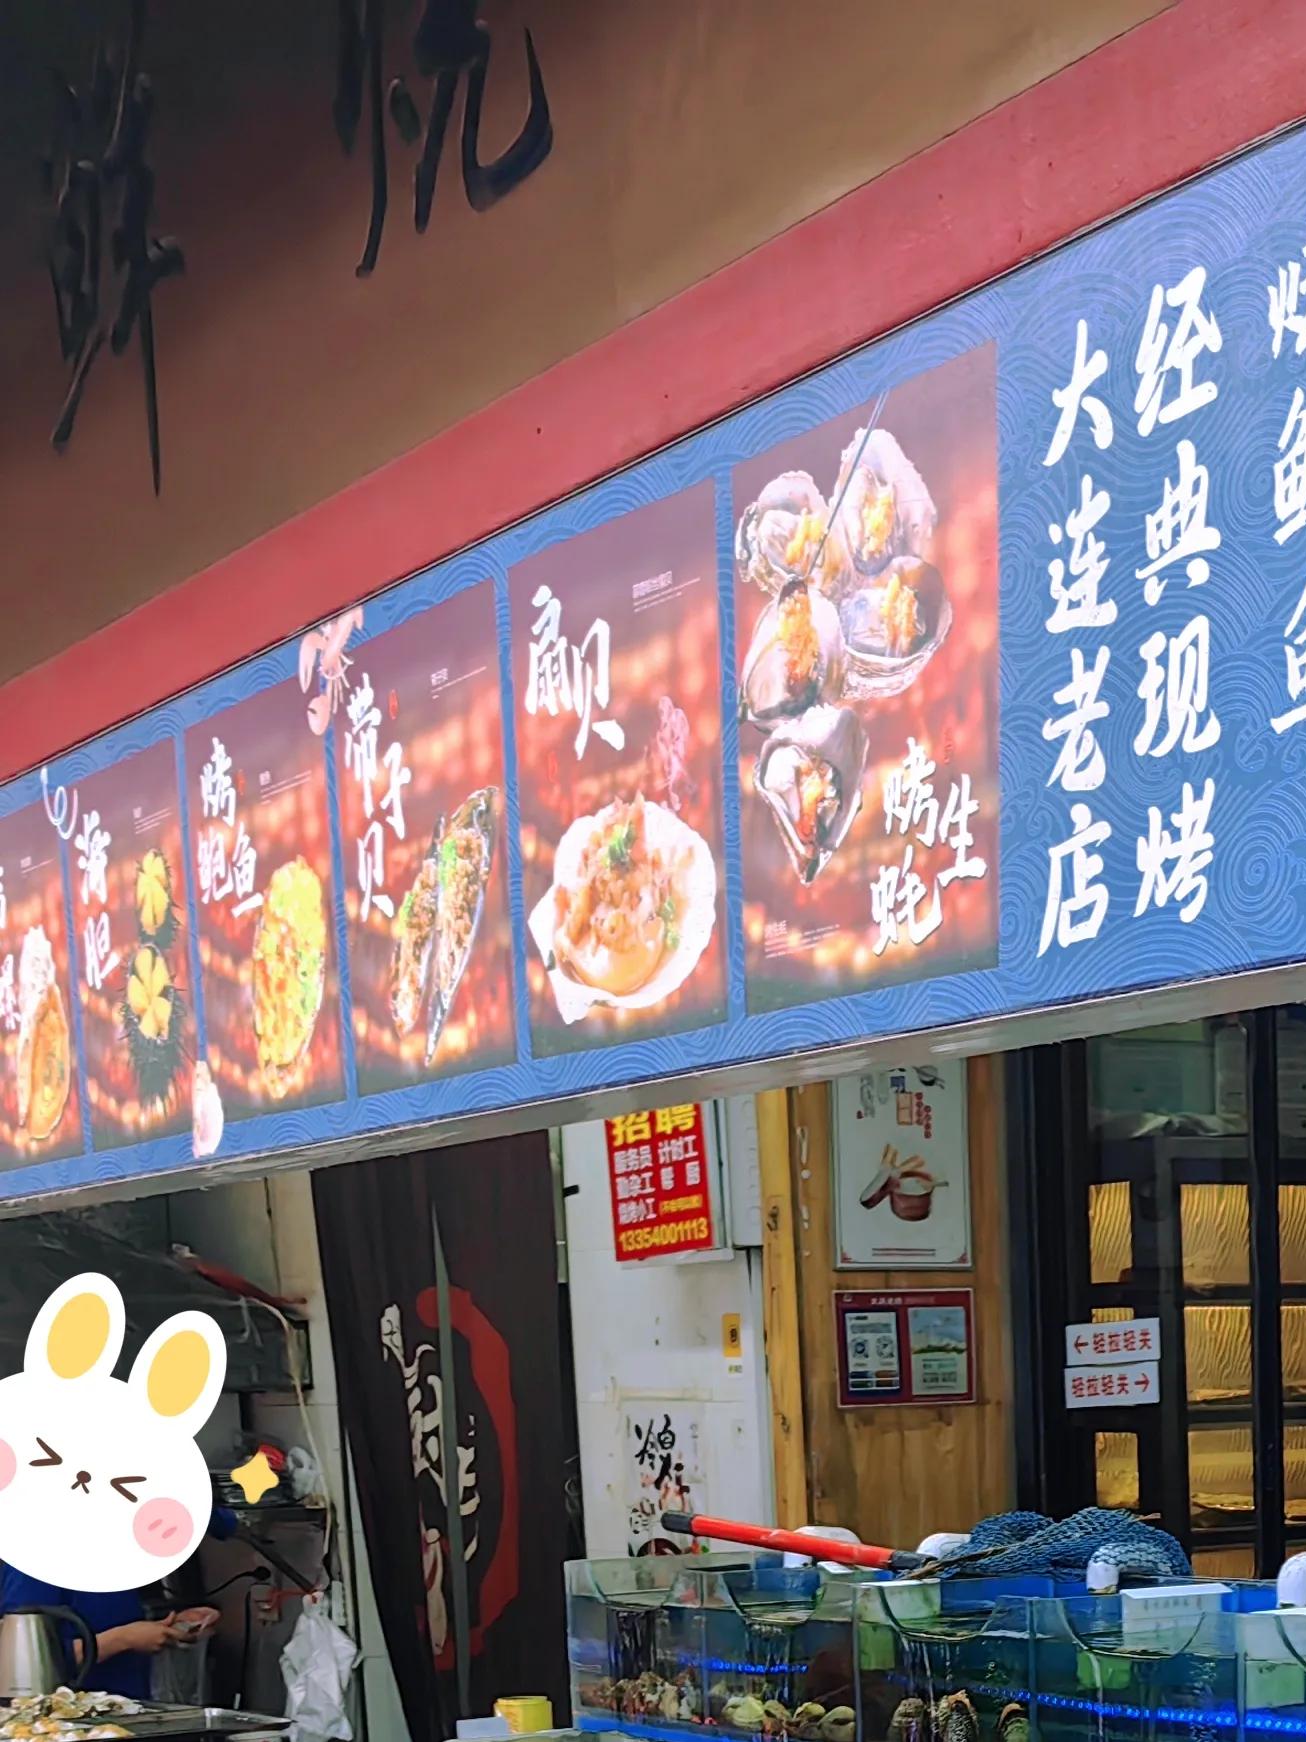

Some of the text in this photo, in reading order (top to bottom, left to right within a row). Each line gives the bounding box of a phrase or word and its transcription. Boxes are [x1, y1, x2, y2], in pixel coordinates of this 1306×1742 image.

[525, 585, 625, 760] 扇贝
[1037, 319, 1117, 959] 大连老店
[1134, 266, 1223, 924] 经典现烤
[198, 737, 264, 918] 烤鲍鱼
[870, 737, 987, 956] 烤生蚝
[612, 1104, 697, 1146] 招聘
[1072, 1374, 1129, 1398] 轻拉轻关
[1093, 1328, 1152, 1354] 轻拉轻关
